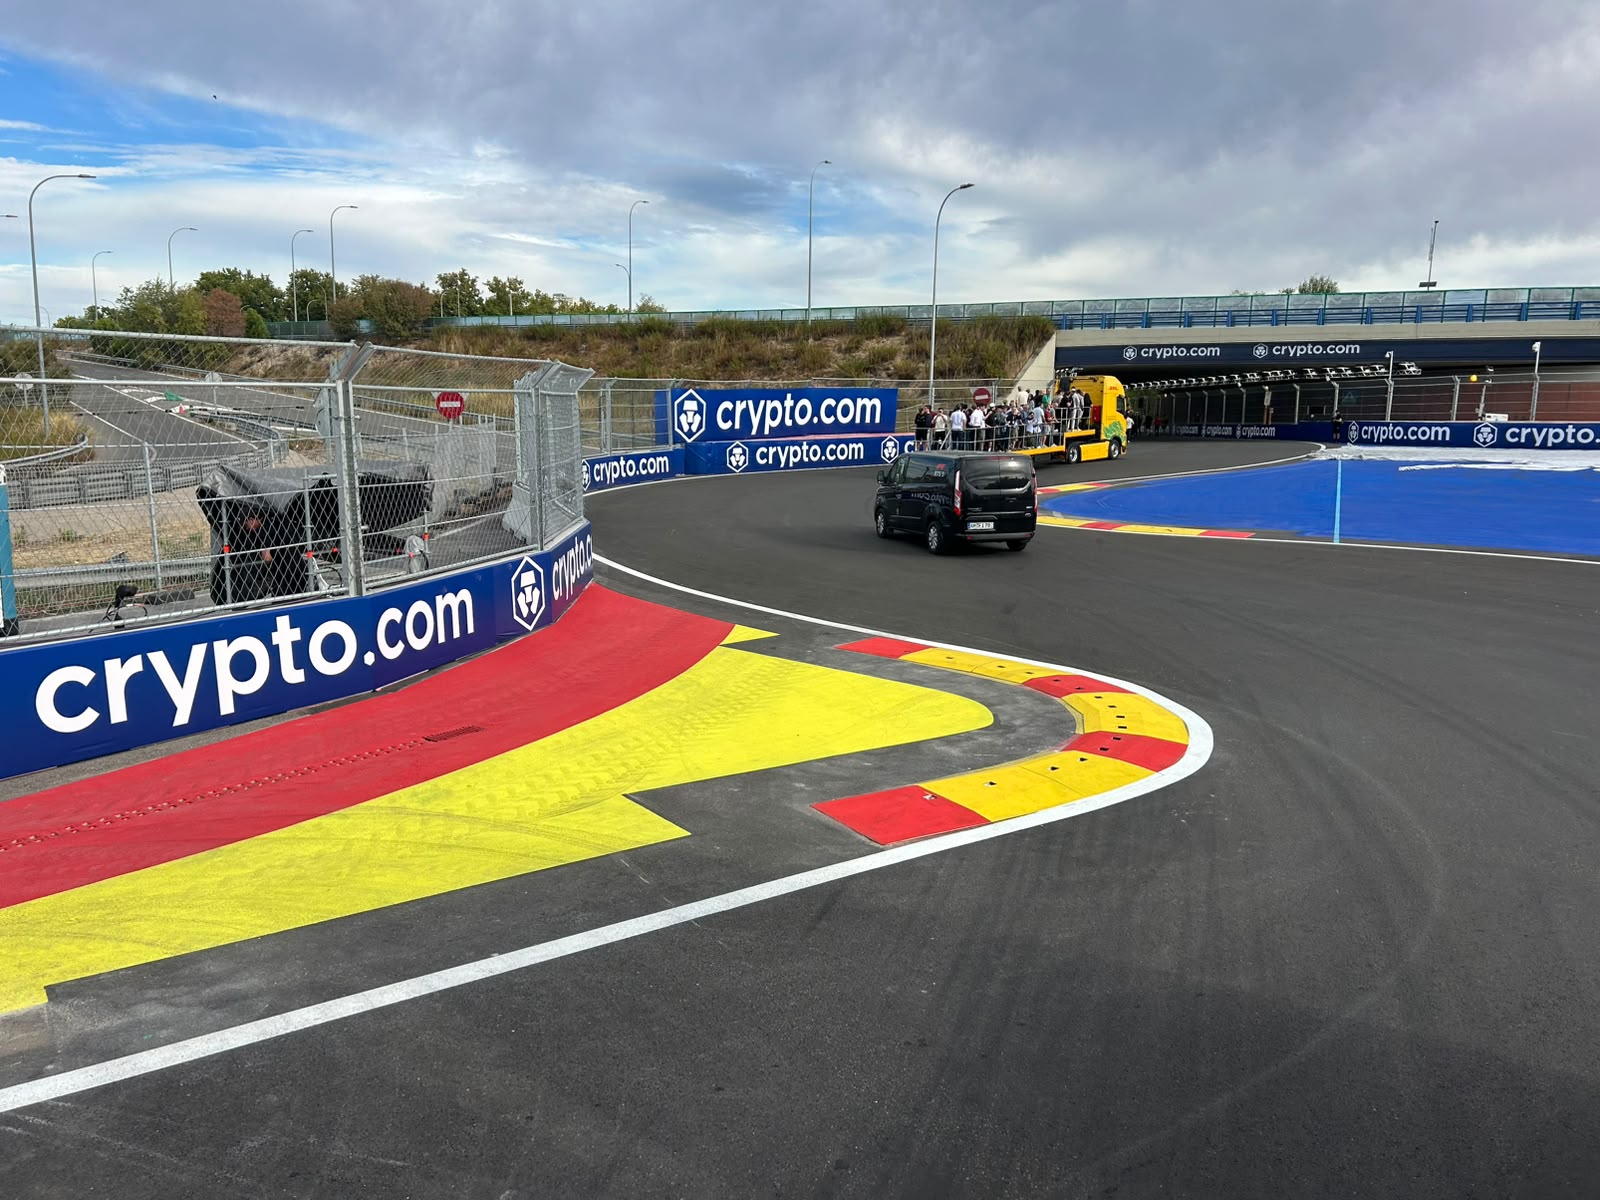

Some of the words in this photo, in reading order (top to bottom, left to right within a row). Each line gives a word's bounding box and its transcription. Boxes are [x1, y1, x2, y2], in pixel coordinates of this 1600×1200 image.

[1140, 345, 1221, 359] crypto.com
[1271, 343, 1361, 357] crypto.com
[716, 393, 882, 436] crypto.com
[1242, 426, 1276, 437] crypto.com
[1361, 423, 1451, 442] crypto.com
[755, 441, 865, 469] crypto.com
[593, 454, 670, 485] crypto.com
[552, 534, 593, 601] crypto.c
[35, 587, 475, 733] crypto.com
